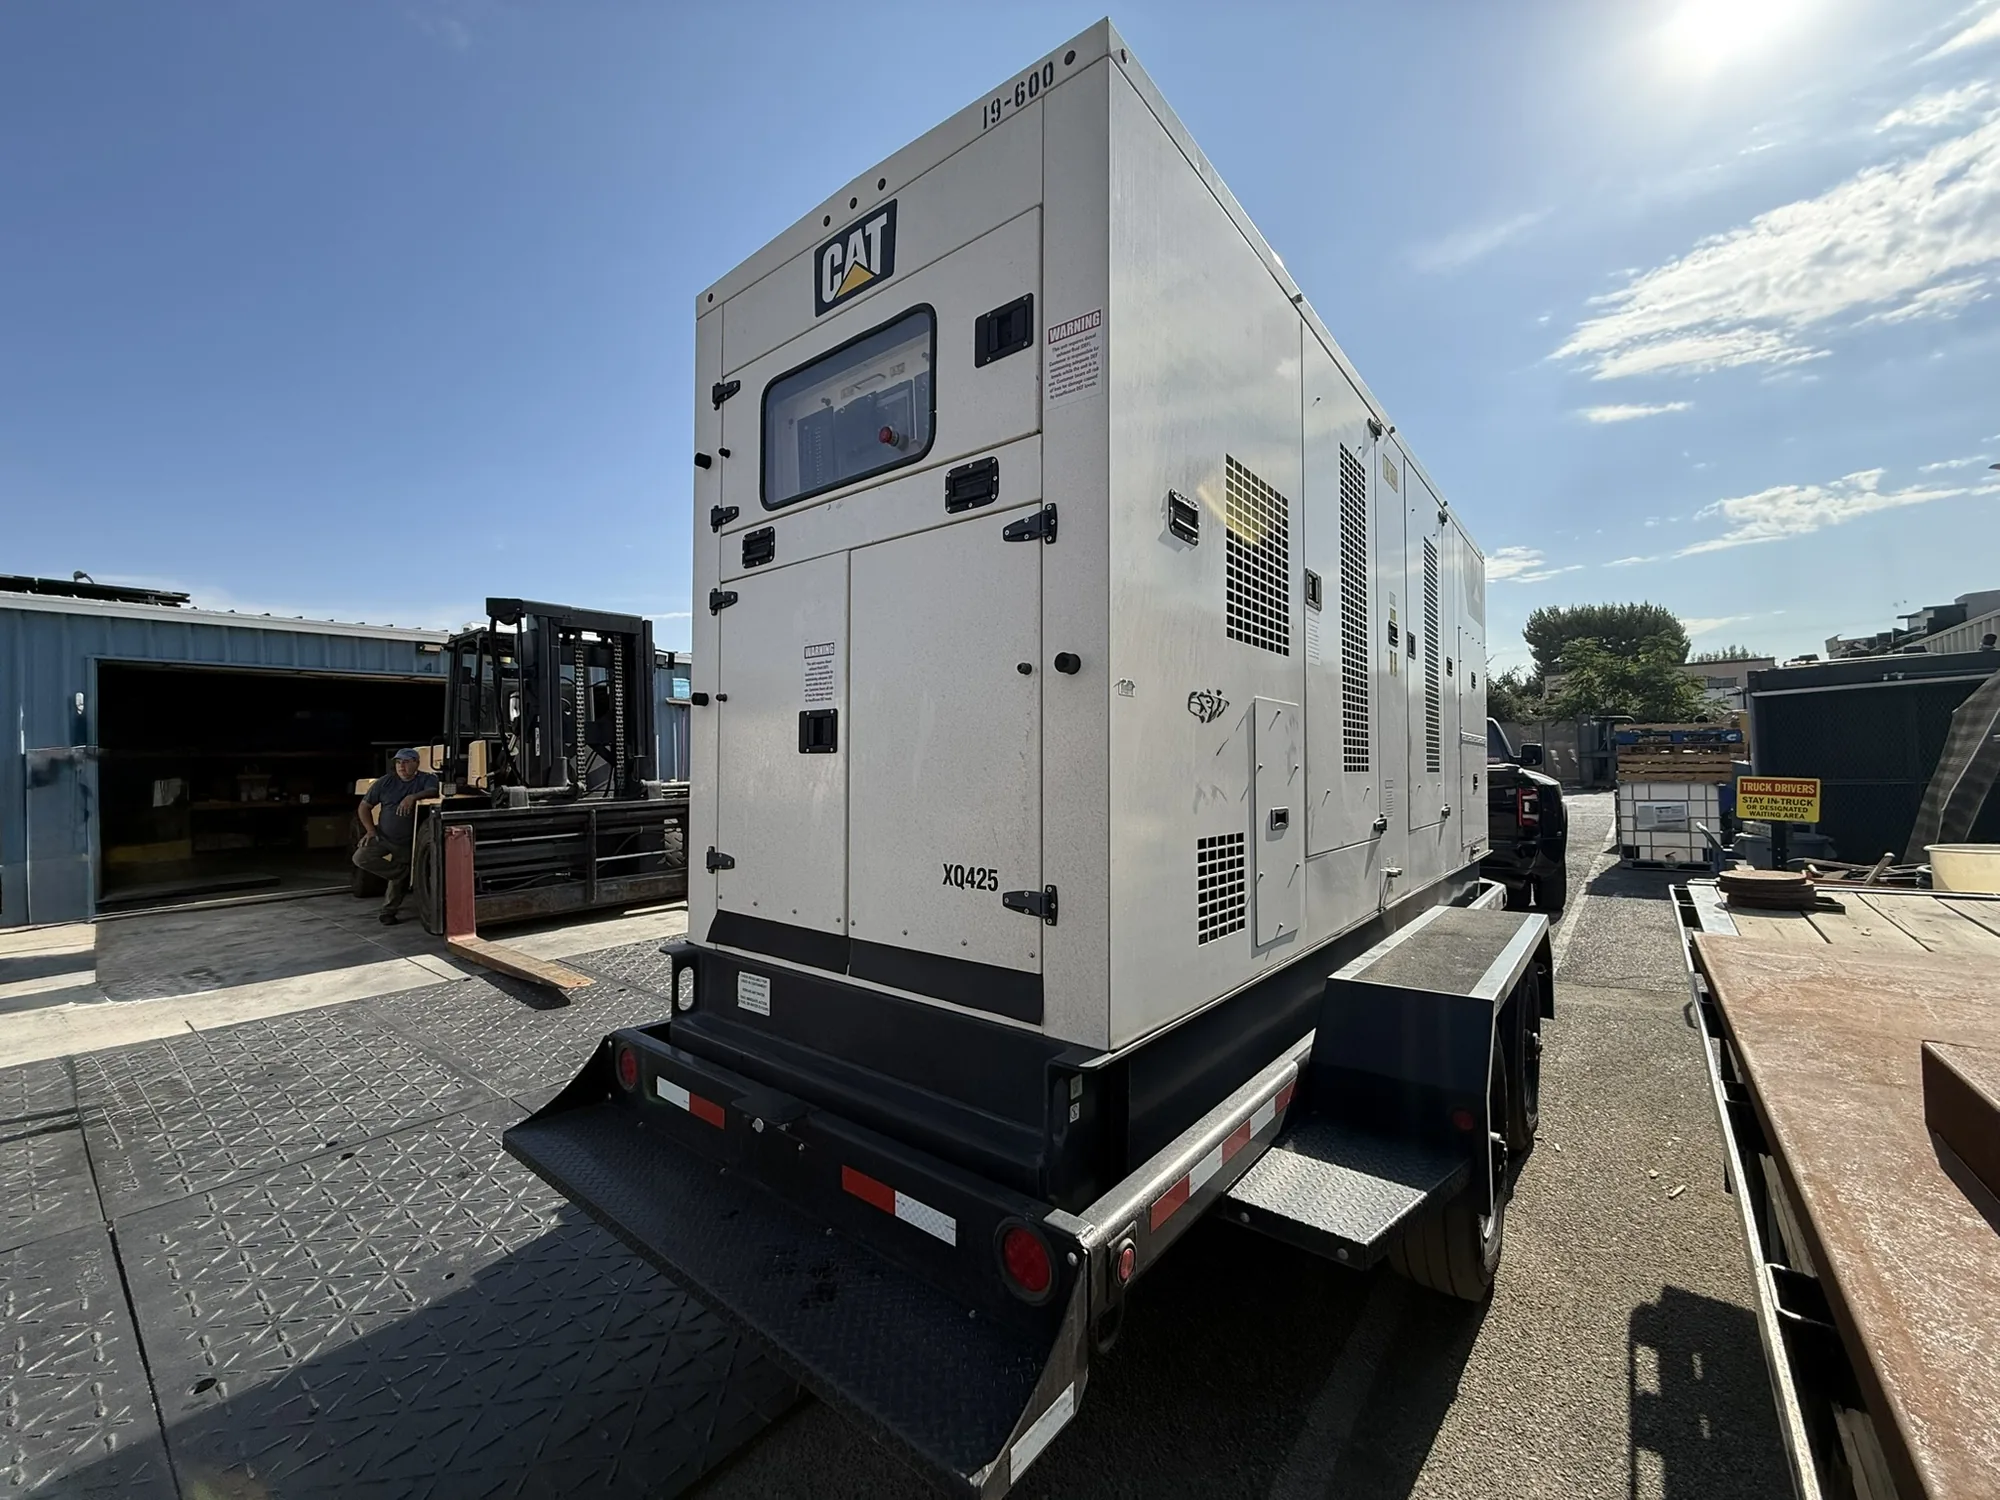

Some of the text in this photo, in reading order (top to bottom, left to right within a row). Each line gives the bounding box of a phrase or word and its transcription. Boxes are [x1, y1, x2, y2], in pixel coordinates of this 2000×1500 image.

[983, 61, 1054, 129] 19-600
[822, 212, 887, 303] CAT
[1049, 312, 1100, 342] WARNING
[805, 643, 834, 657] WARNING
[1742, 782, 1815, 794] TRUCK DRIVERS
[1742, 796, 1764, 804] STAY
[1749, 810, 1781, 818] WAITING
[1760, 805, 1808, 813] DESIGNATED
[942, 863, 998, 892] XQ425
